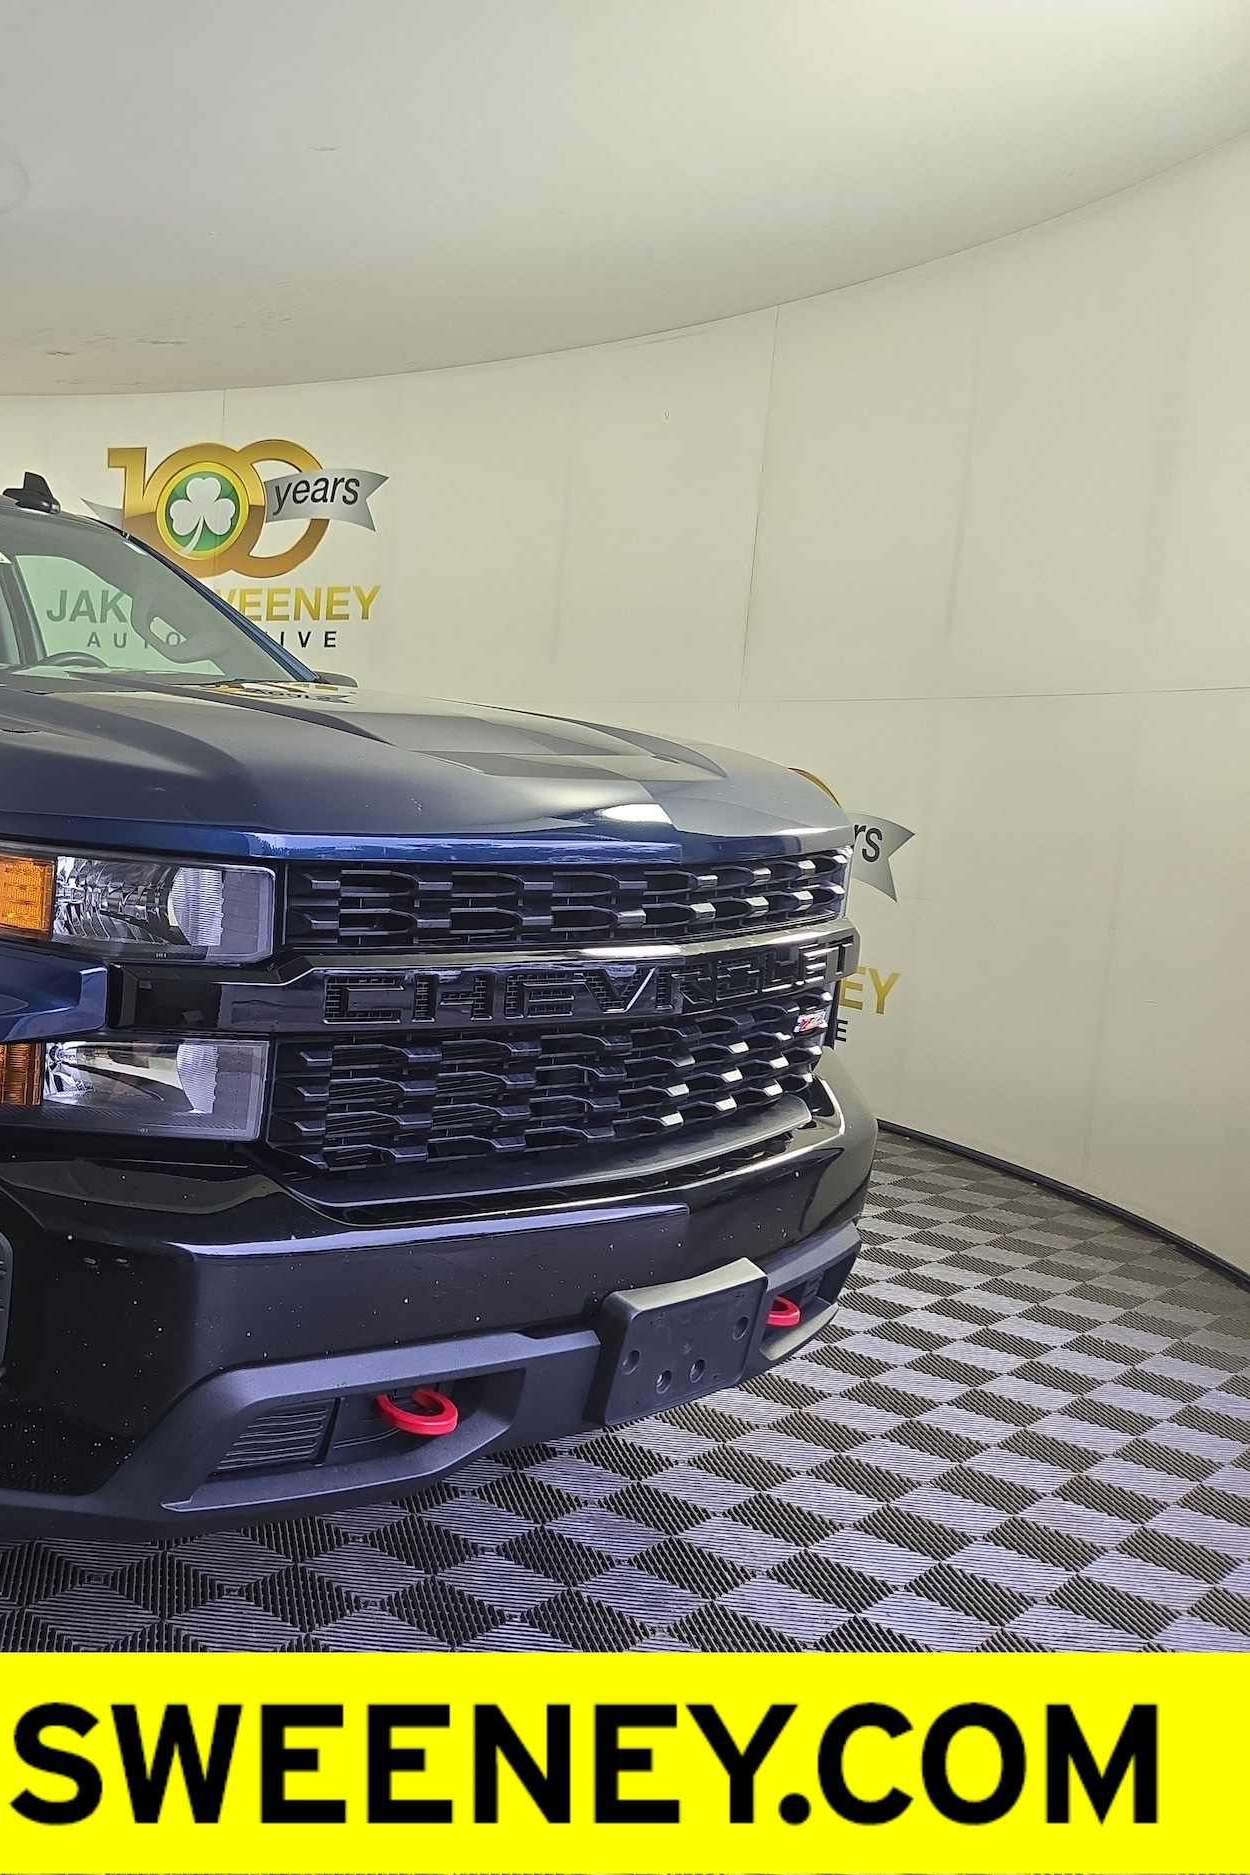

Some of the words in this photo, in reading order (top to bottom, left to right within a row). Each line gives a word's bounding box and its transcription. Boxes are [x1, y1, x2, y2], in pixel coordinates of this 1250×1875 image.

[106, 438, 331, 578] 100
[271, 475, 362, 517] years
[46, 588, 133, 625] JAK
[217, 585, 382, 622] EENEY
[322, 941, 854, 1025] CHEVROLET
